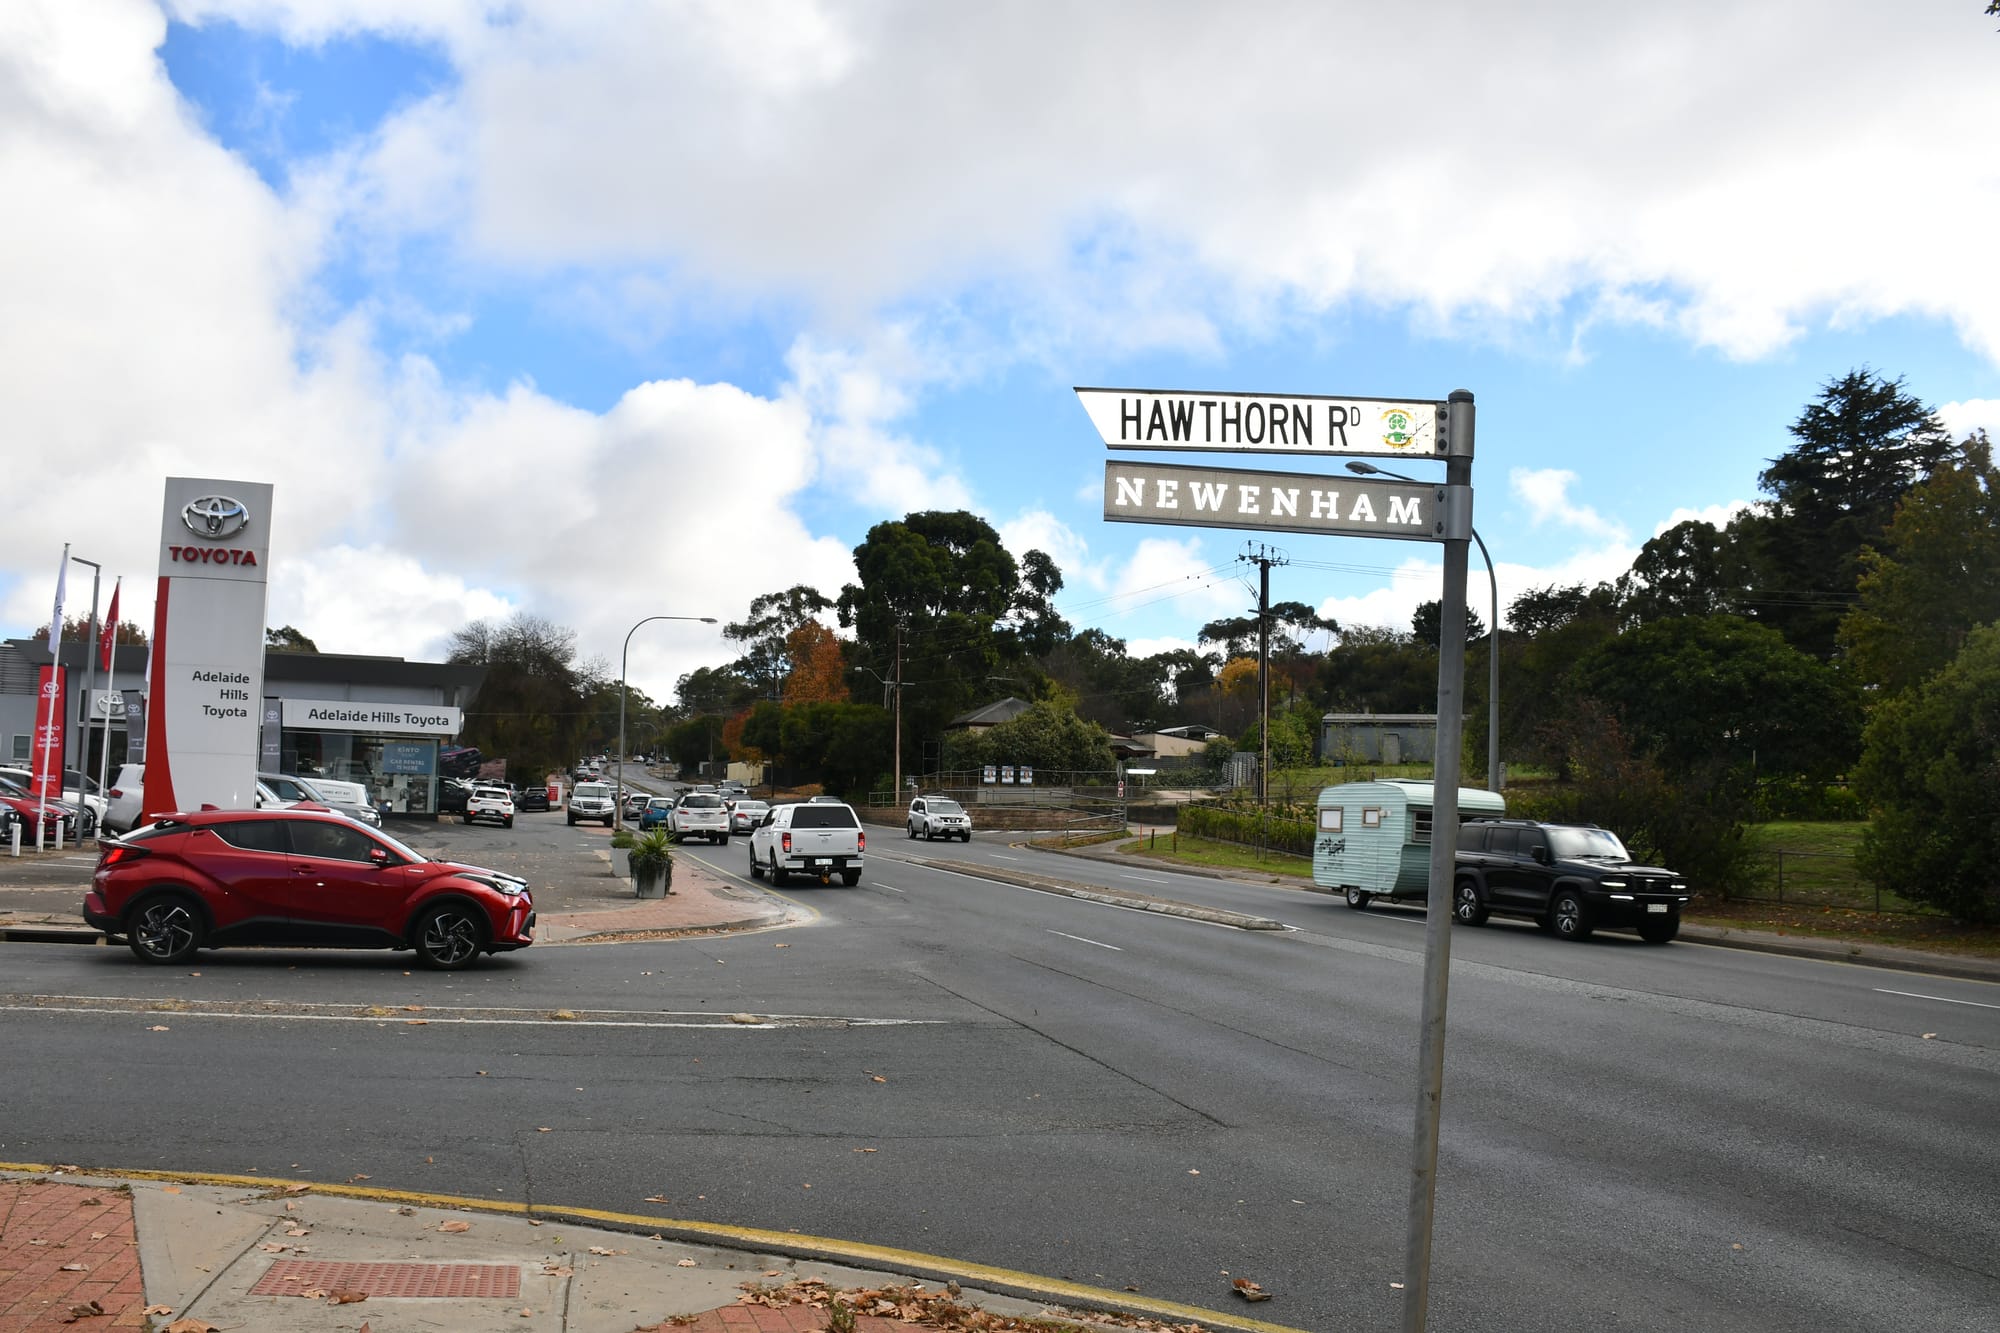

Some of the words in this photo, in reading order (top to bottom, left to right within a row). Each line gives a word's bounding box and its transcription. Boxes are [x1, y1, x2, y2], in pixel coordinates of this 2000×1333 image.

[1120, 398, 1313, 446] HAWTHORN
[1115, 476, 1423, 526] NEWENHAM
[168, 546, 257, 567] TOYOTA
[192, 670, 250, 684] Adelaide
[220, 688, 249, 701] Hills
[202, 704, 248, 719] Toyota
[308, 708, 369, 722] Adelaide
[371, 711, 401, 724] Hills
[404, 713, 450, 728] Toyota
